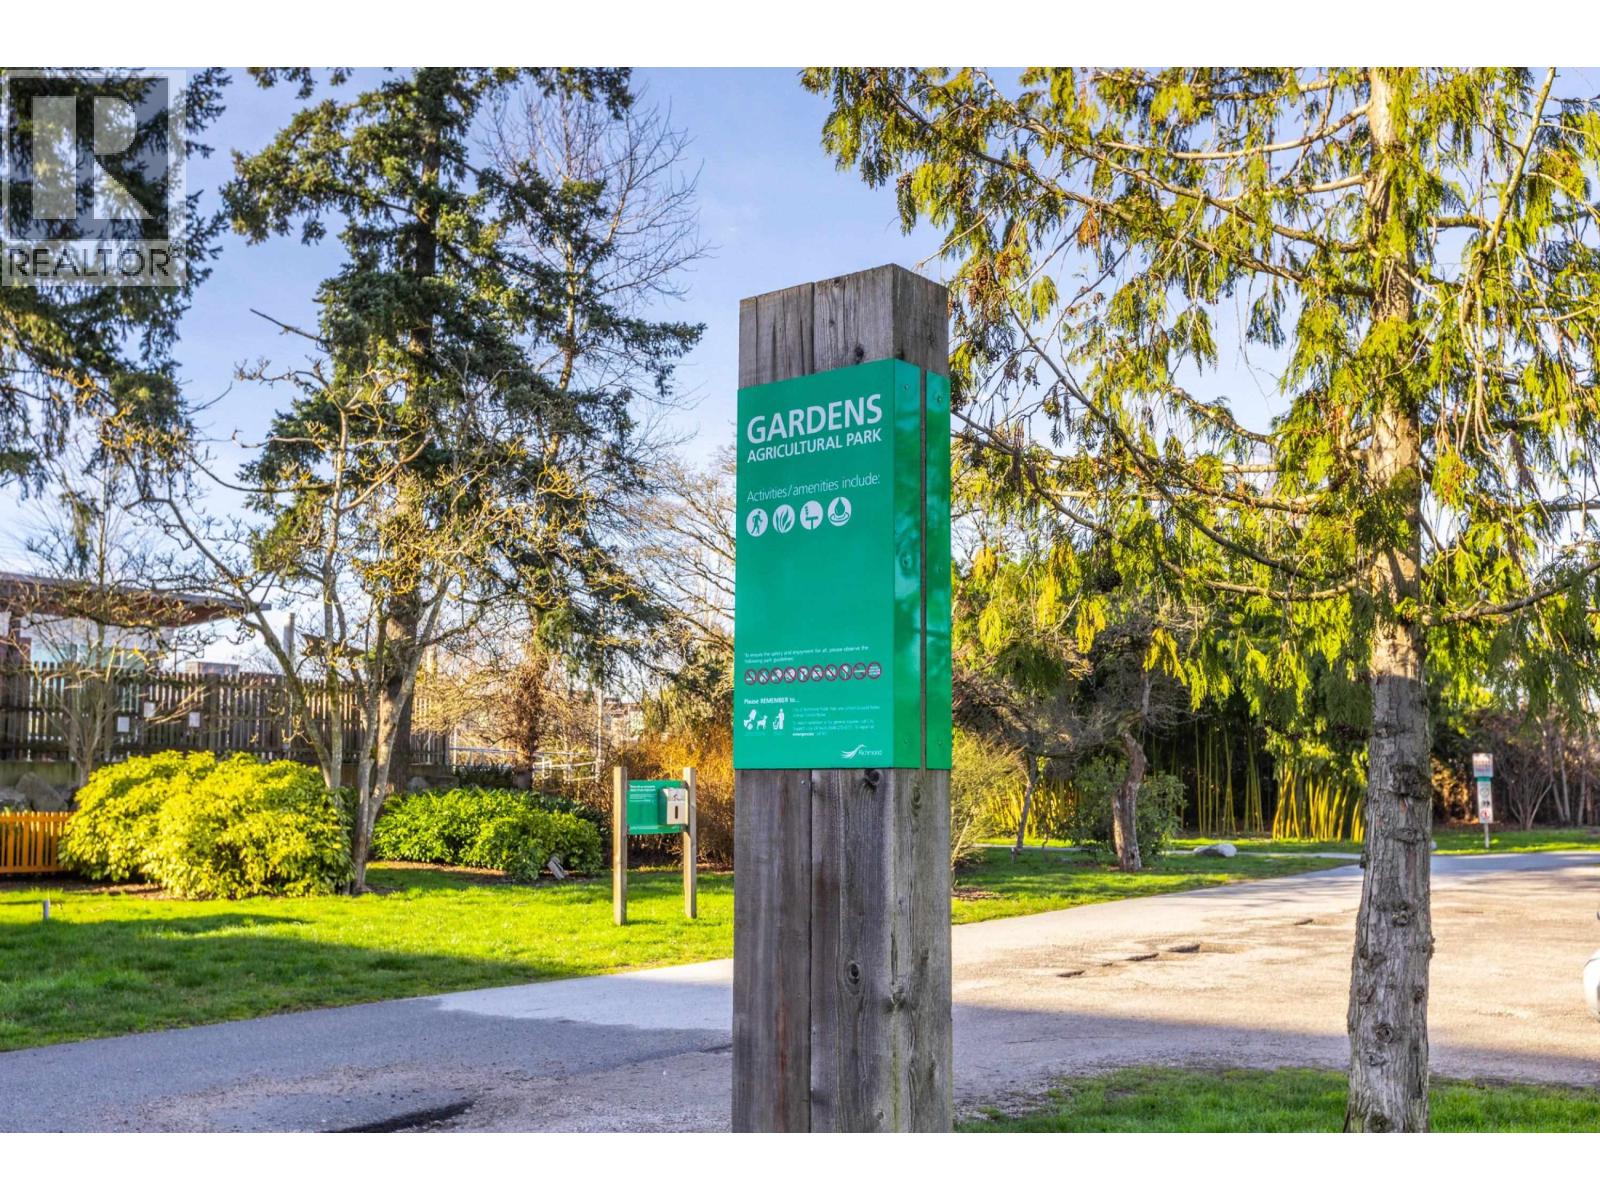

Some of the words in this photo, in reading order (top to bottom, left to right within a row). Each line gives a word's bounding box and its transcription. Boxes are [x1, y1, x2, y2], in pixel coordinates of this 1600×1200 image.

[747, 394, 883, 444] GARDENS
[747, 434, 842, 463] AGRICULTURAL
[846, 428, 882, 447] PARK
[747, 479, 839, 502] Activities/amenities
[841, 473, 881, 489] include:
